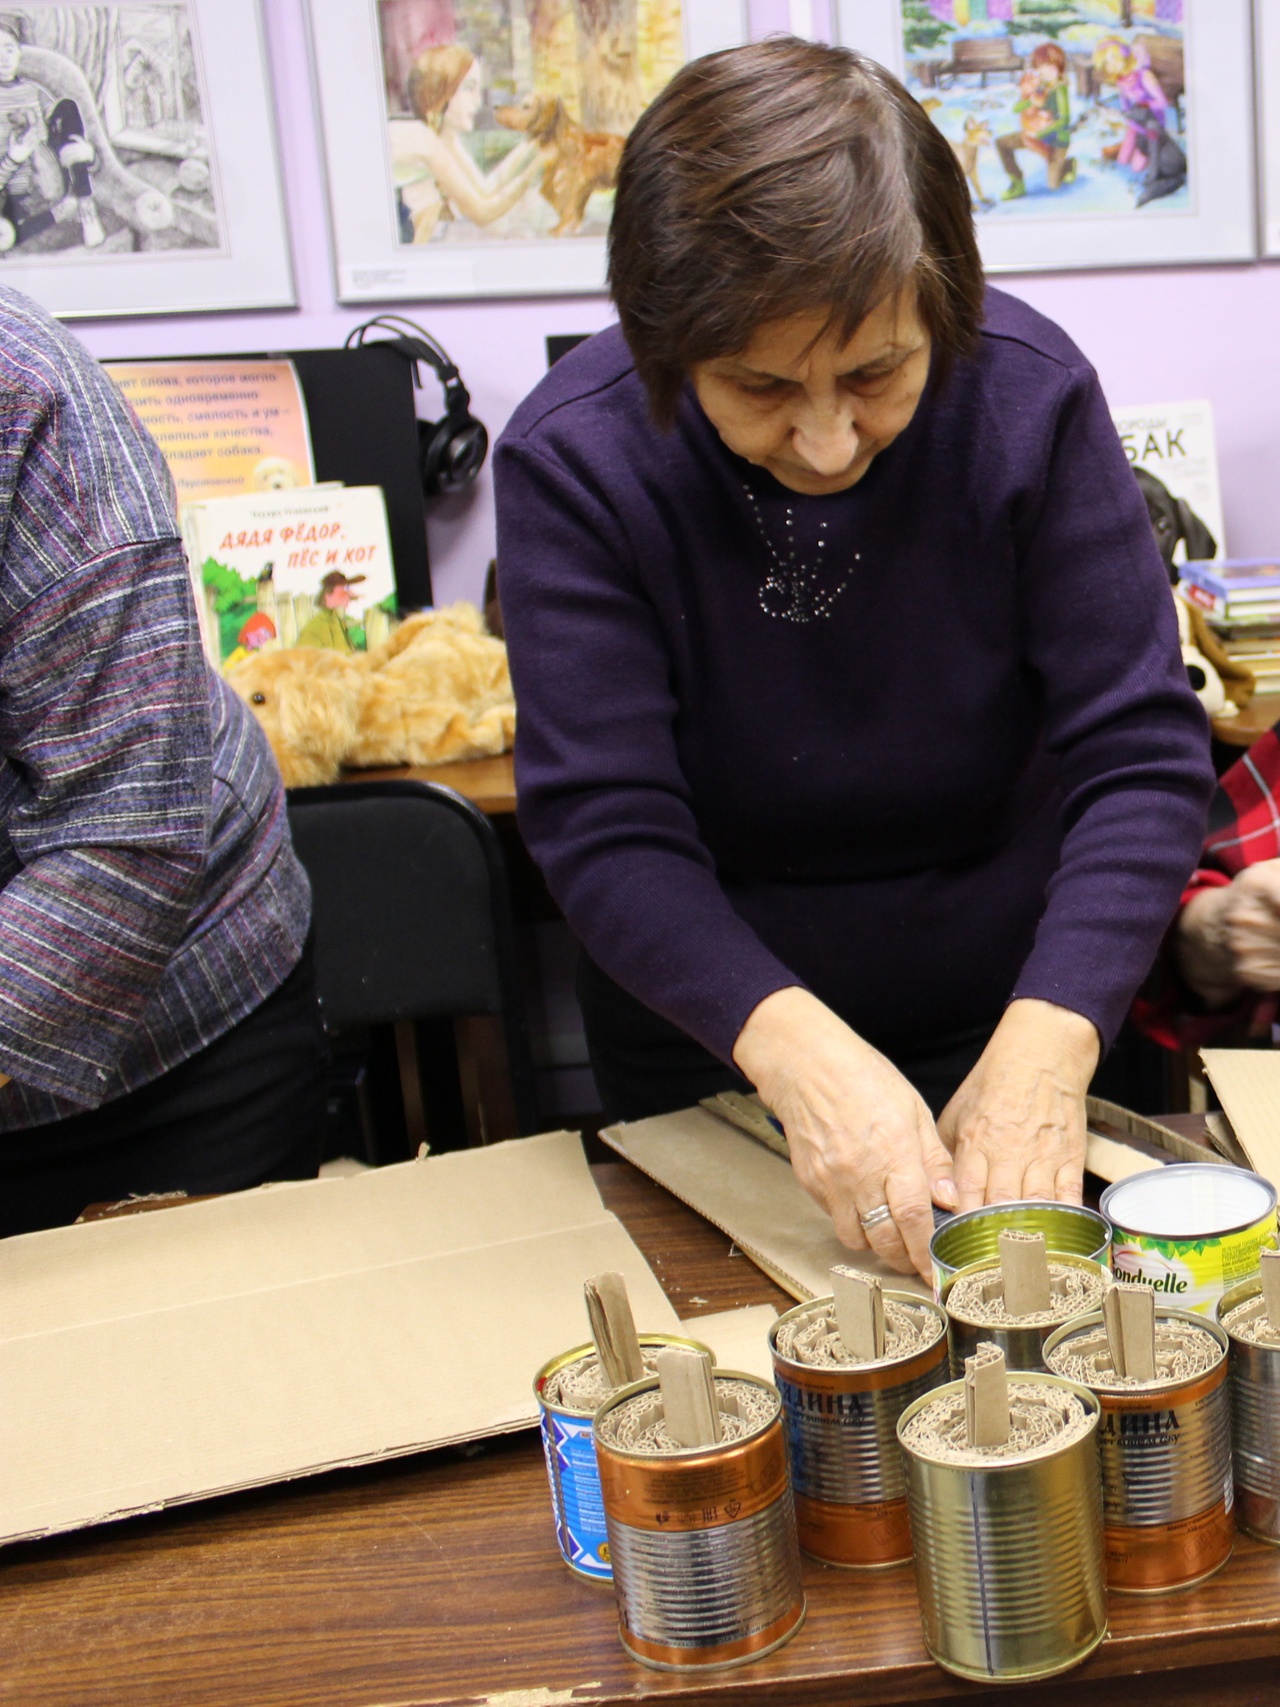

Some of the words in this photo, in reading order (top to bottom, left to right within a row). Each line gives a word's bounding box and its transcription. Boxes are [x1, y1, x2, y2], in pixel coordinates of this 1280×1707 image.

[185, 374, 237, 388] которое
[239, 373, 277, 384] могло
[165, 391, 259, 407] одновременно
[187, 410, 249, 423] смелость
[251, 411, 260, 419] и
[261, 408, 279, 421] ум
[1115, 416, 1168, 432] ОРОДЫ
[161, 449, 214, 461] бладает
[1120, 428, 1188, 463] БАК
[219, 528, 274, 551] ДЯДЯ
[287, 548, 320, 570] ПЁС
[325, 550, 338, 564] И
[342, 544, 378, 563] КОТ
[1115, 1267, 1188, 1294] ondelle
[779, 1378, 864, 1416] ЯДИНА
[1098, 1409, 1181, 1437] ДИНА
